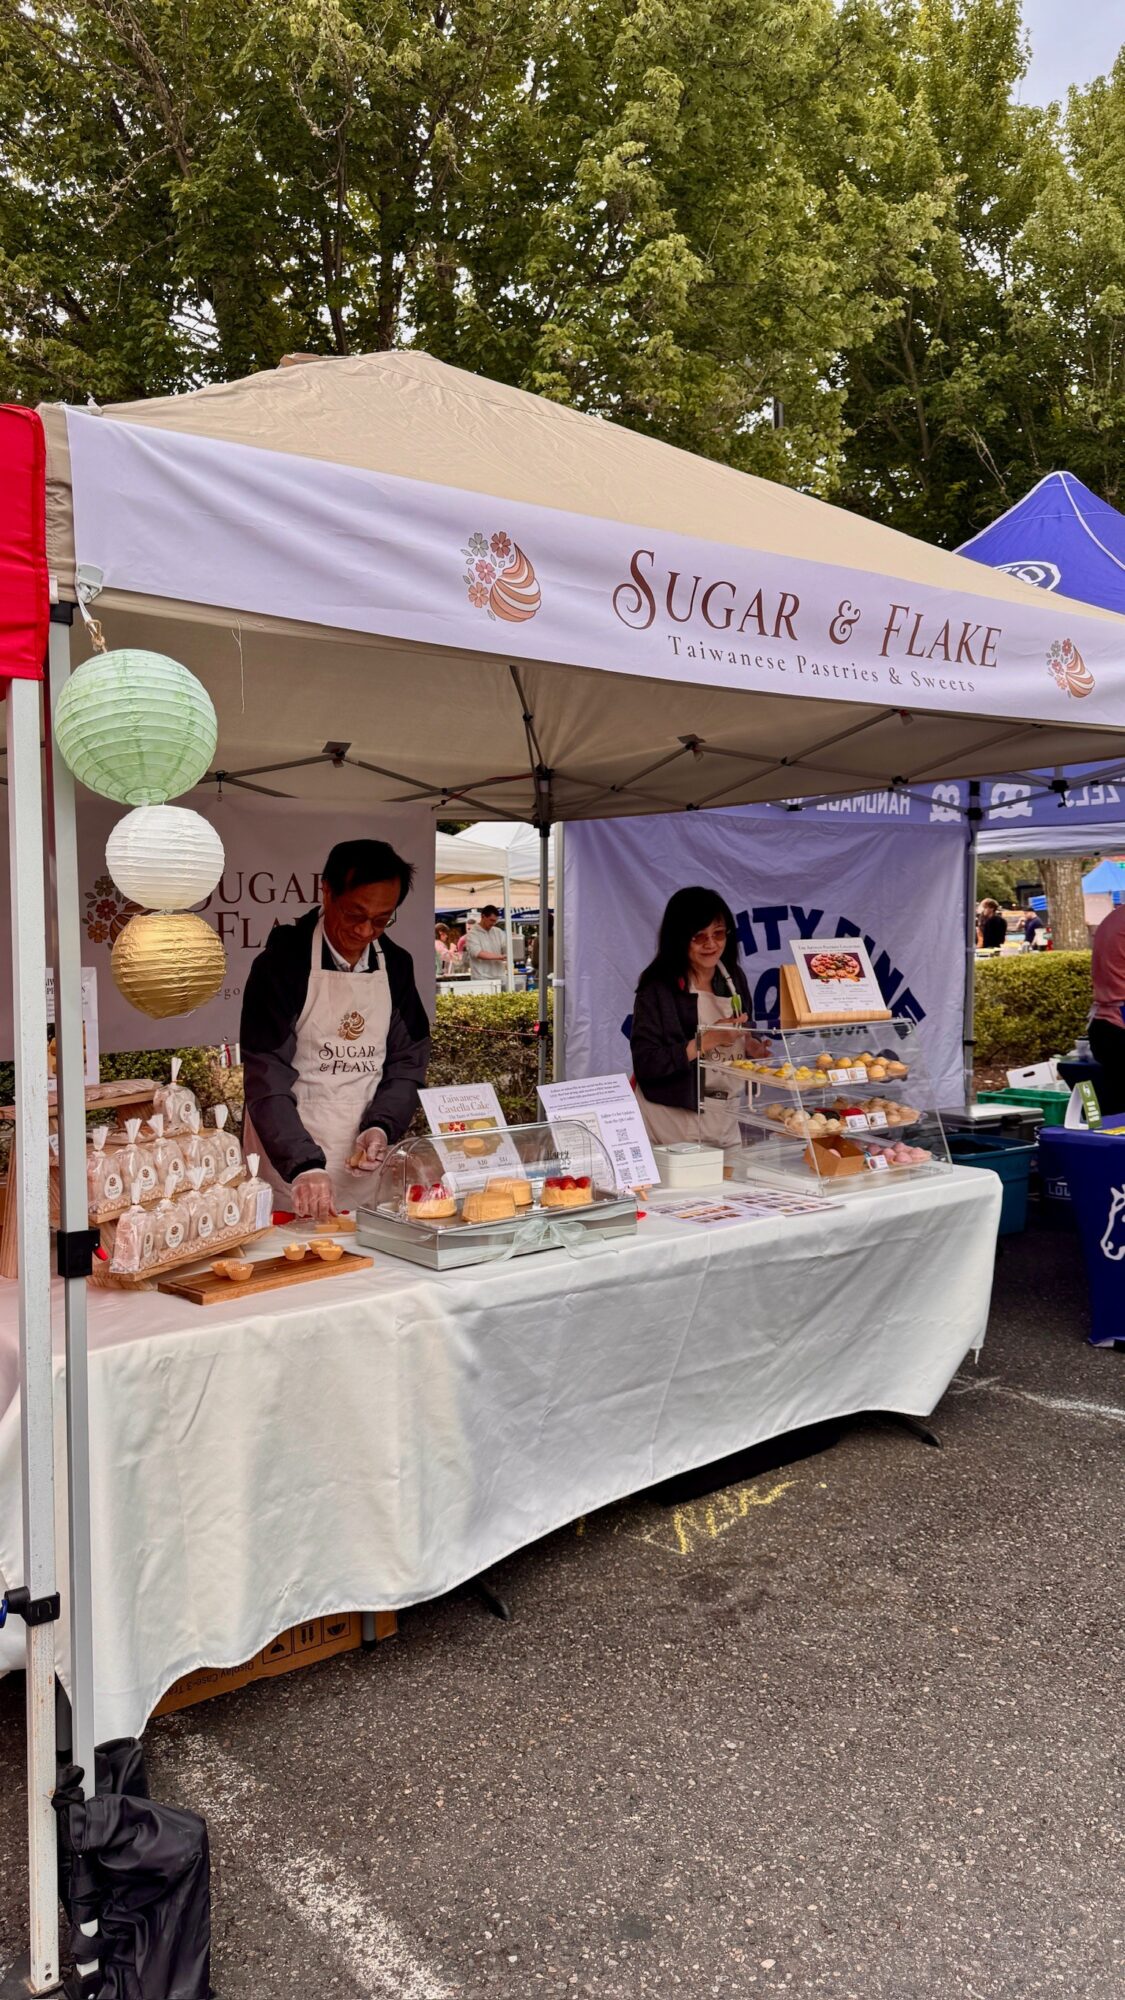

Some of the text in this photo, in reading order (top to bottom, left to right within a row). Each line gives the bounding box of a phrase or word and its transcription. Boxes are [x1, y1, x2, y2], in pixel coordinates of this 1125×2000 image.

[612, 549, 1002, 668] SUGAR & FLAKE
[668, 635, 975, 692] Taiwanese Pastries & Sweets
[319, 1042, 376, 1060] SUGAR
[320, 1060, 378, 1075] & FLAKE
[440, 1093, 480, 1104] Taiwanese
[438, 1100, 490, 1114] Castella Cake
